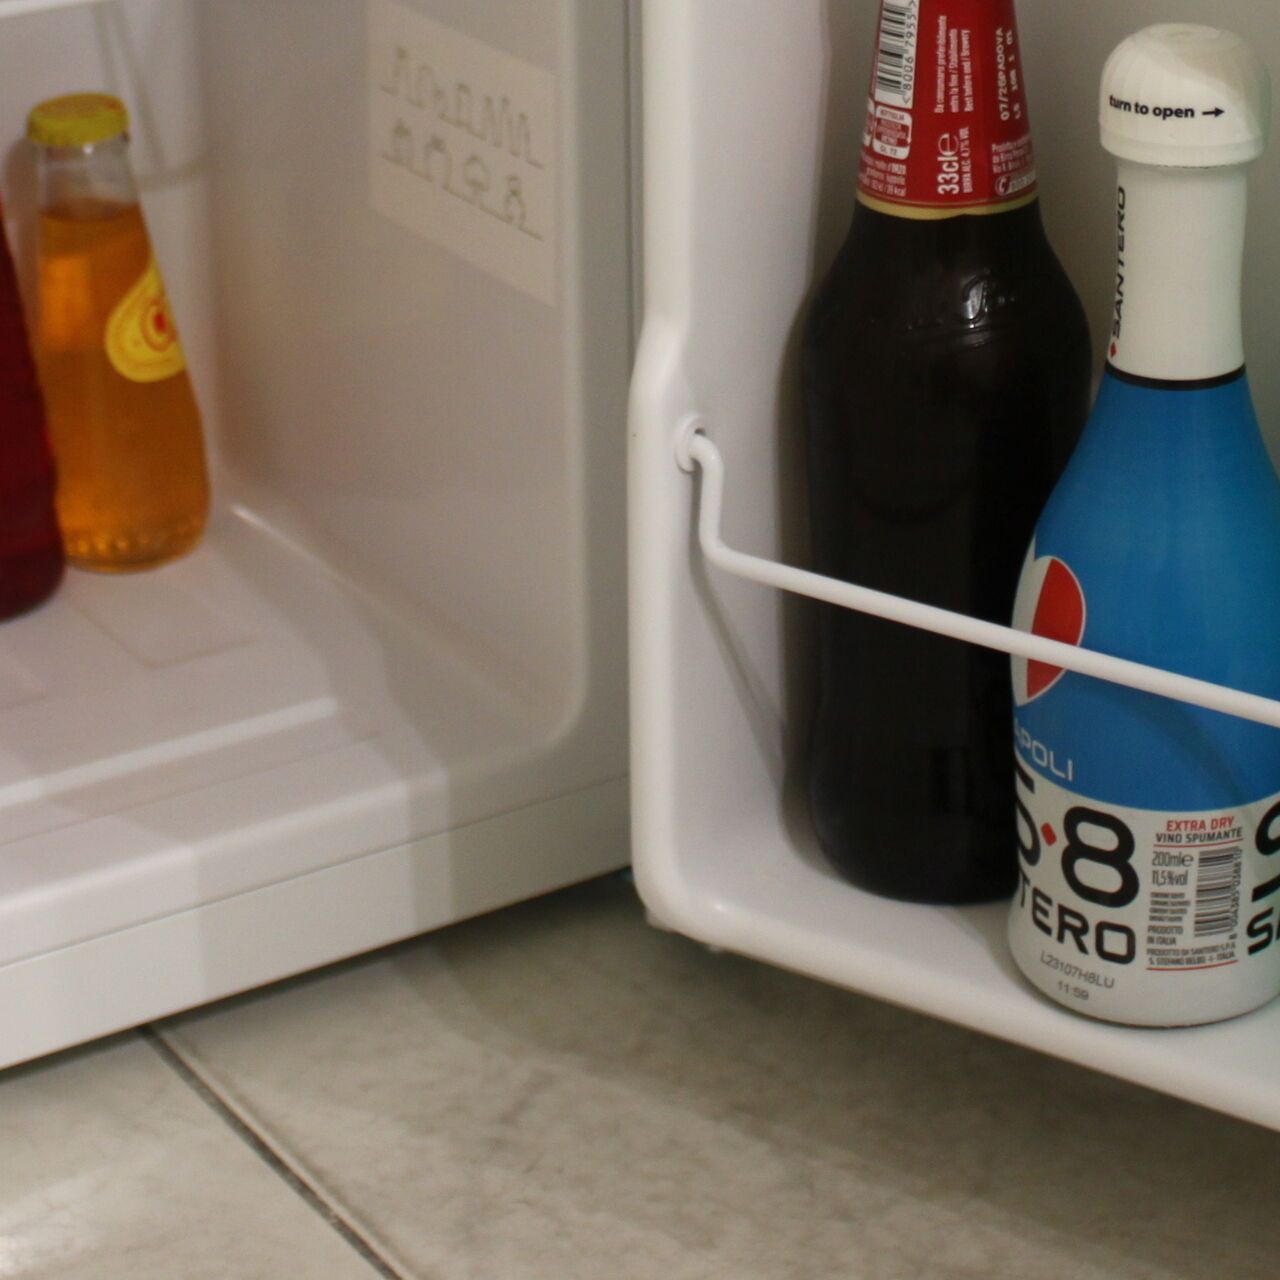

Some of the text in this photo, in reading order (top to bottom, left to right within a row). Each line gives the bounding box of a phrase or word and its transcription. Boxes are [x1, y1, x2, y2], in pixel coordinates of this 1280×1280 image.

[1134, 98, 1149, 115] to
[1152, 104, 1196, 121] open
[1166, 816, 1235, 831] EXTRA DRY
[1155, 826, 1244, 844] VINO SPUMANTE
[1061, 805, 1140, 909] 8
